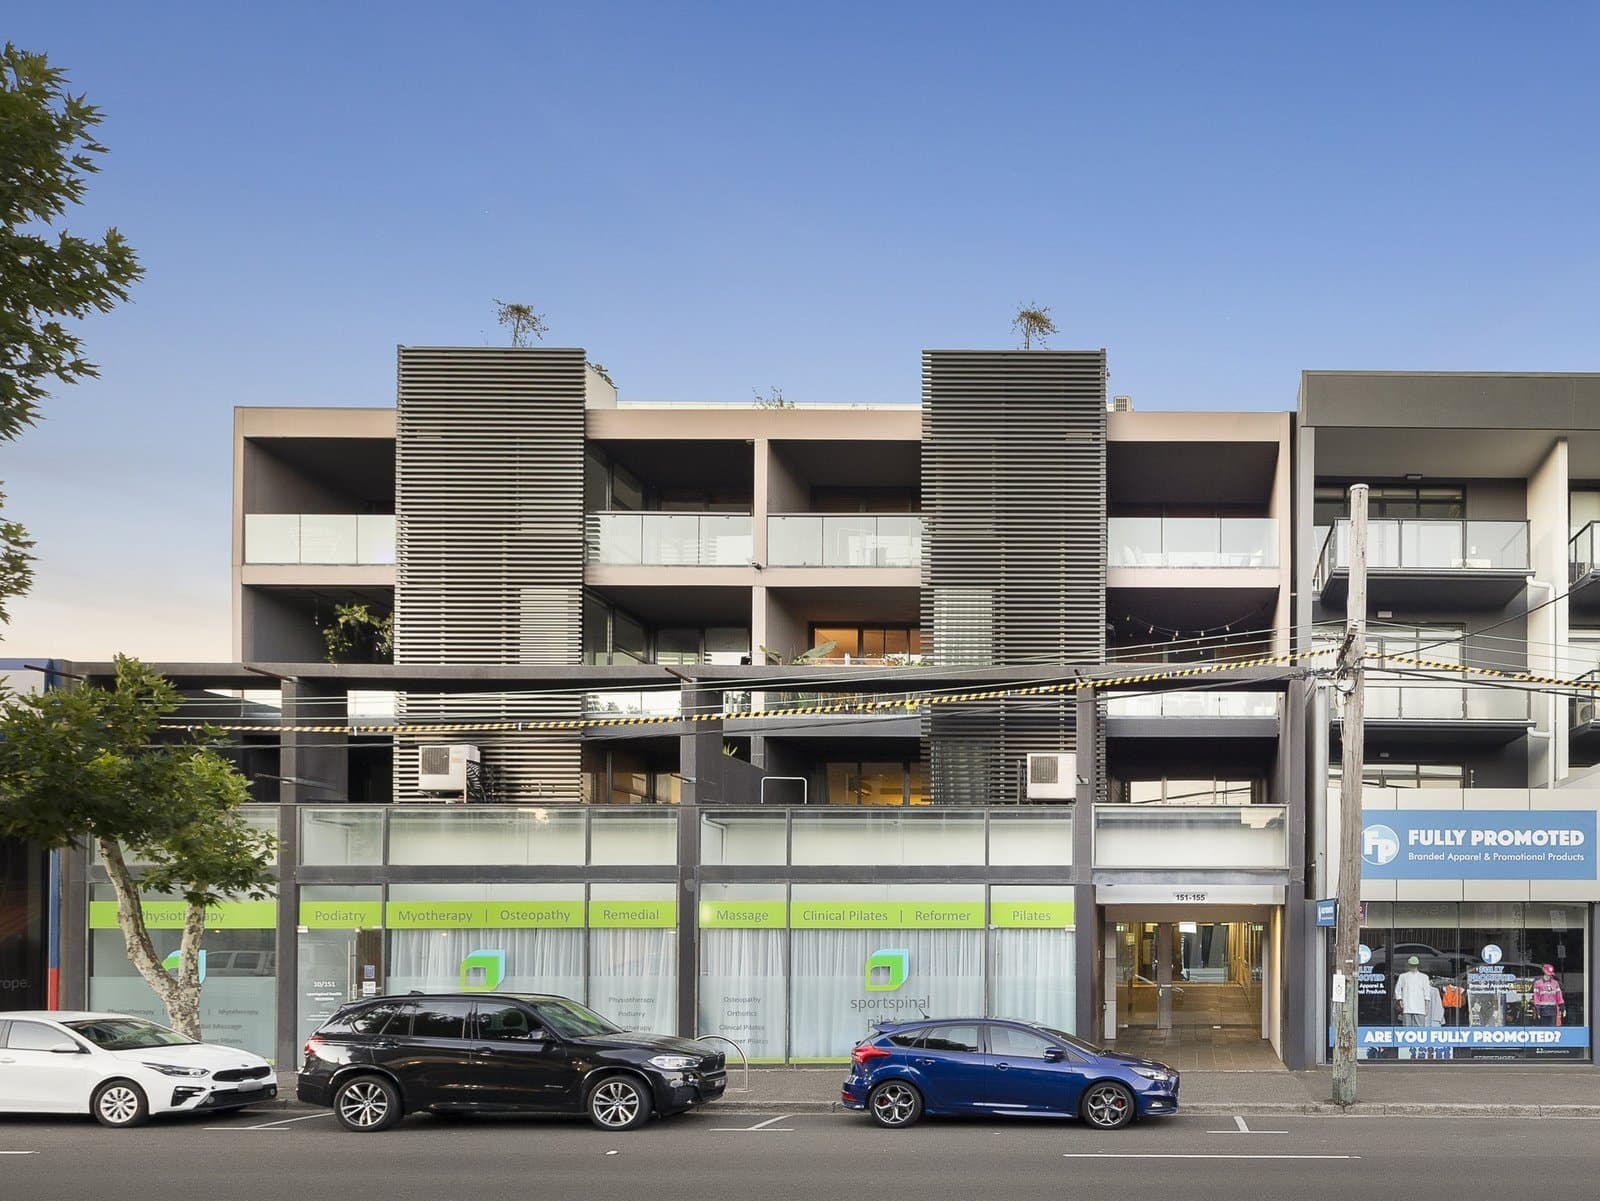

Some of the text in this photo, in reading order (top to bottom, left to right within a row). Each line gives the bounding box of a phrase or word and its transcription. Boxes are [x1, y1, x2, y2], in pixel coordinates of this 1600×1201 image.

[1408, 829, 1585, 846] FULLY PROMOTED
[1408, 852, 1585, 863] Branded Apparel & Promotional Products
[314, 909, 366, 924] Podiatry
[398, 909, 571, 924] Myotherapy Osteopathy
[603, 908, 659, 921] Remedial
[716, 910, 769, 924] Massage
[802, 909, 971, 921] Clinical Pilates Reformer
[1012, 910, 1051, 921] Pilates
[850, 994, 930, 1012] sportspinal
[1364, 1030, 1562, 1043] ARE YOU FULLY PROMOTED?
